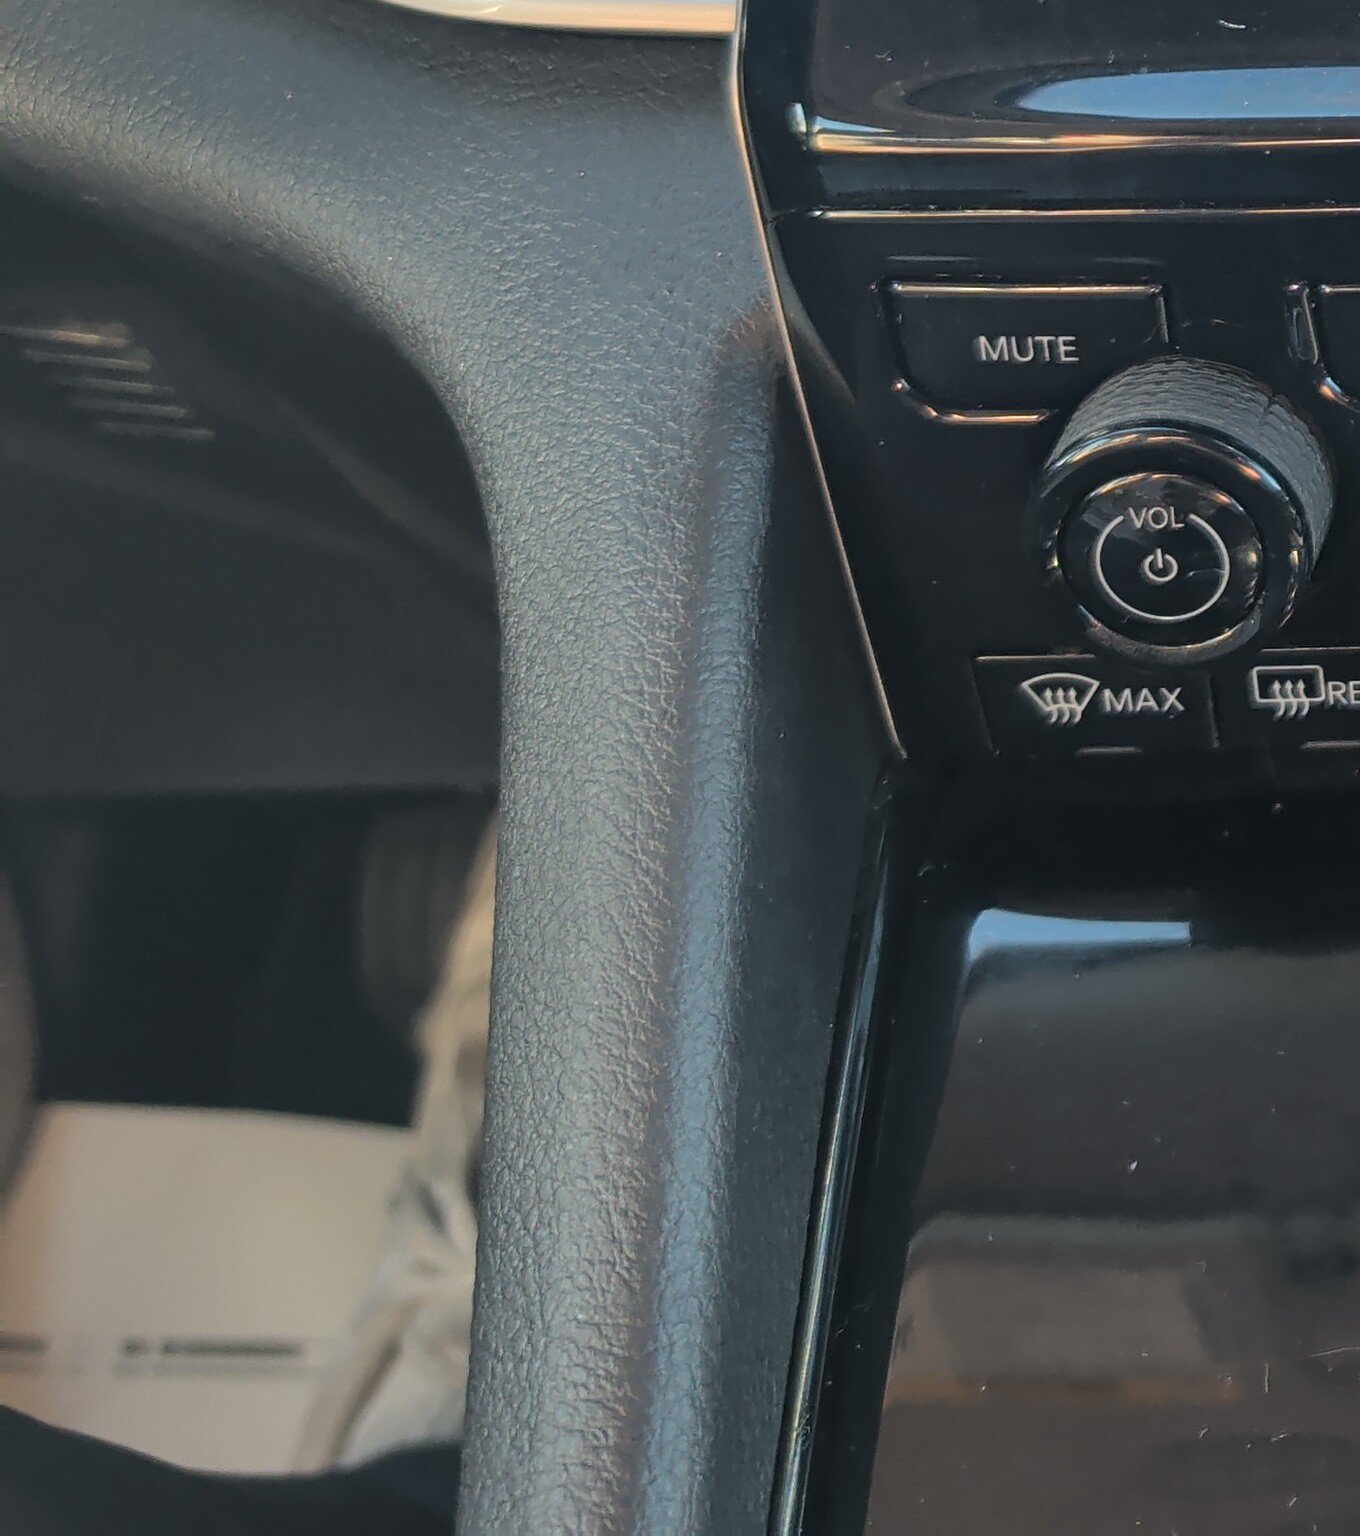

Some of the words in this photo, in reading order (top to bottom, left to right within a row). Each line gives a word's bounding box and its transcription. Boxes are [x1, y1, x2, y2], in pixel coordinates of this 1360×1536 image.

[977, 335, 1080, 363] MUTE
[1127, 506, 1186, 530] VOL
[1103, 686, 1186, 713] MAX
